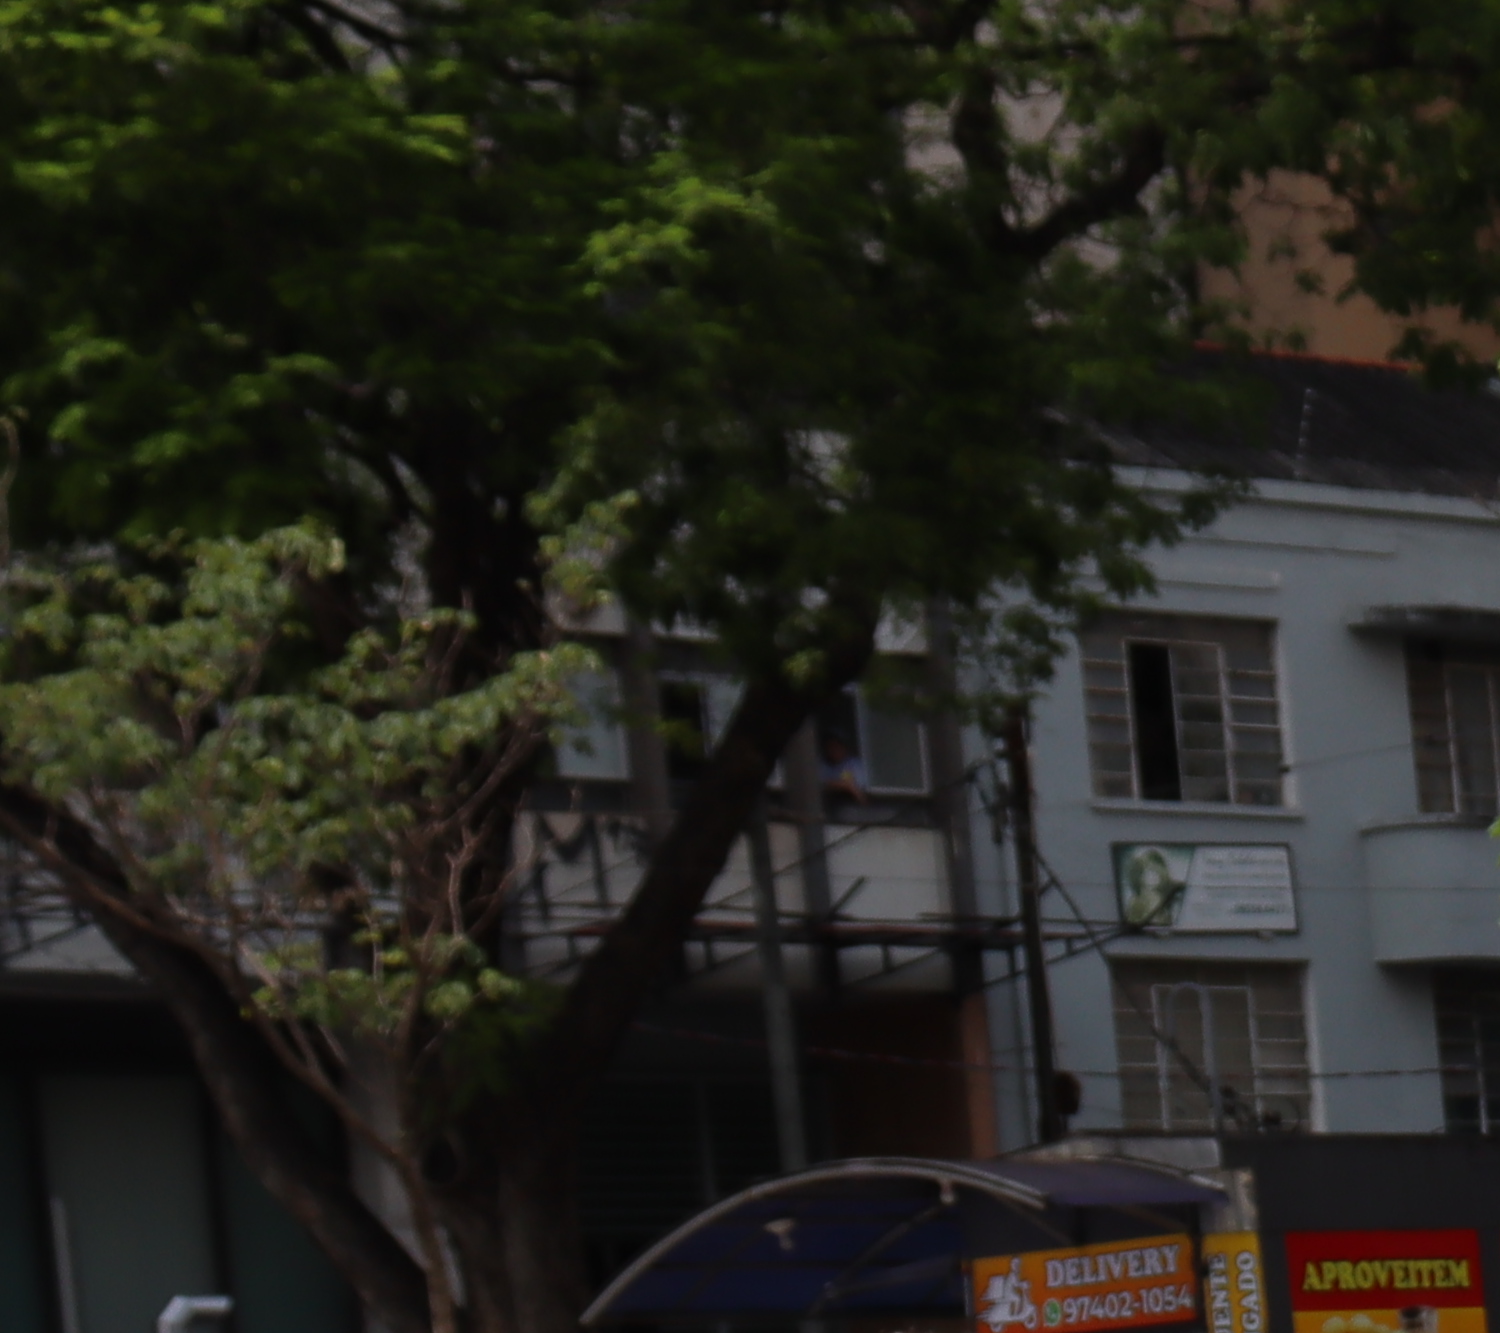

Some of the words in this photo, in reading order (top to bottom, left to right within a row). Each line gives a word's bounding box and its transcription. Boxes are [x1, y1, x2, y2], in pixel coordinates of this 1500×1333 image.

[1045, 1245, 1181, 1288] DELIVERY
[1303, 1259, 1471, 1291] APROVEITEM
[1063, 1284, 1193, 1323] 97402-1054
